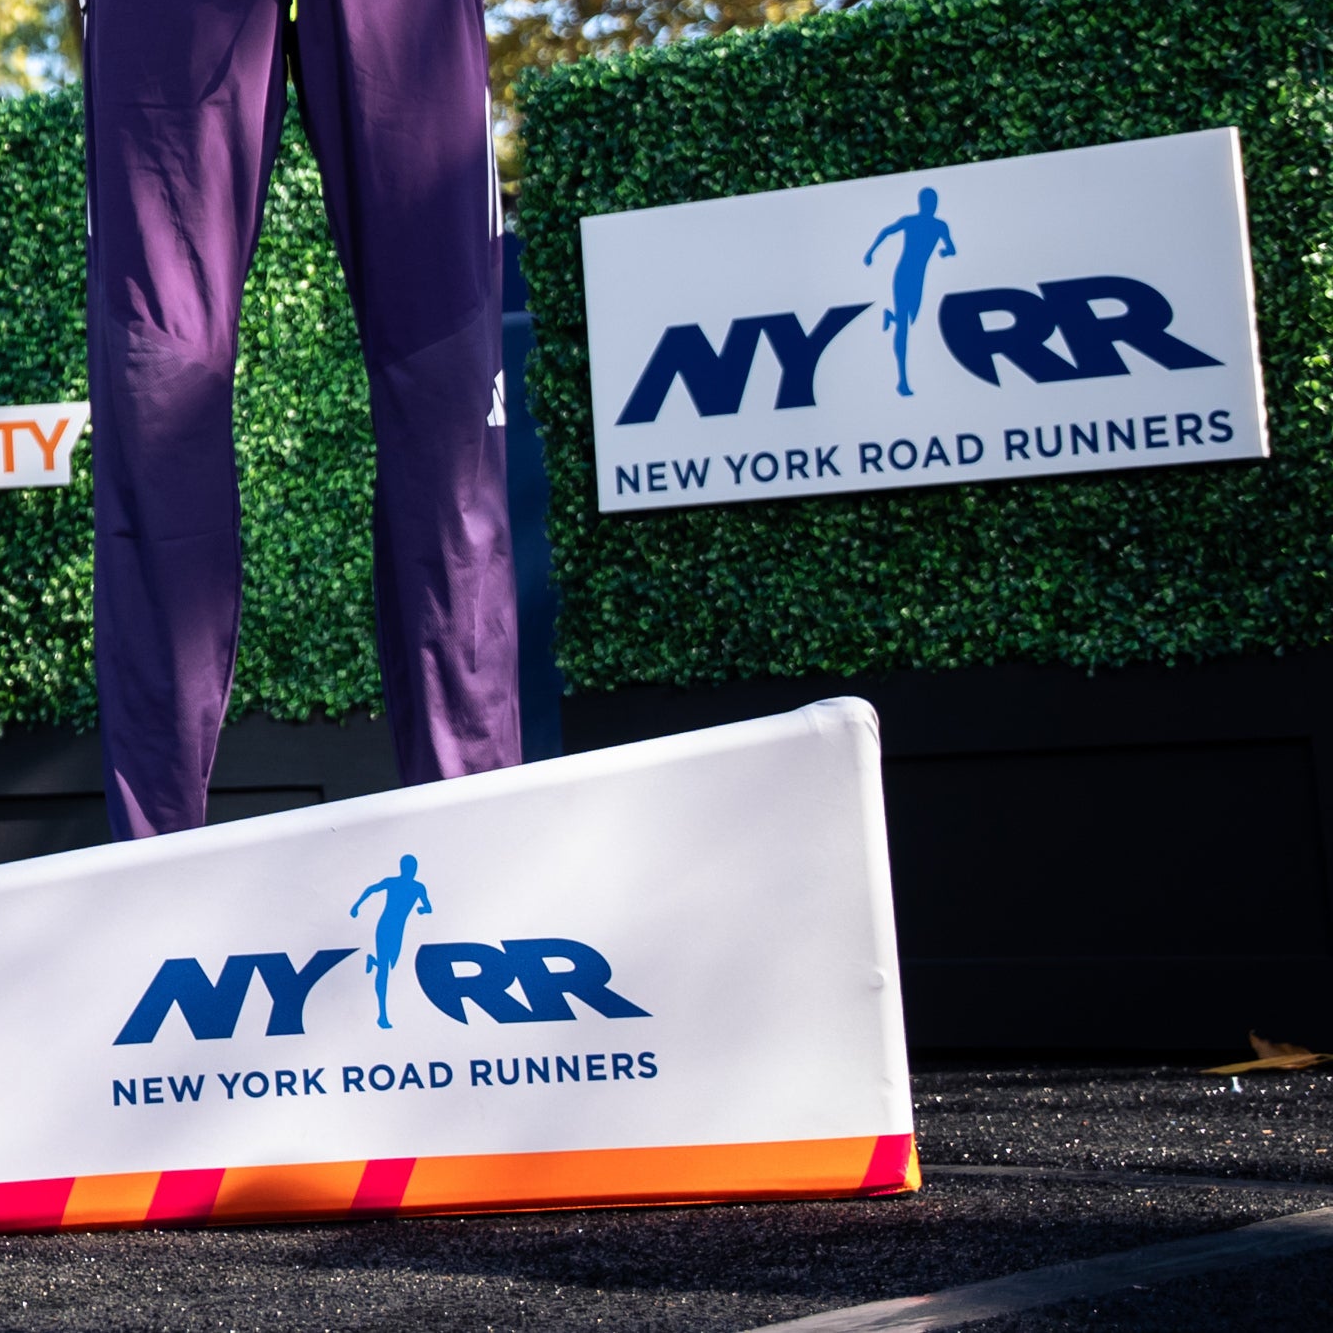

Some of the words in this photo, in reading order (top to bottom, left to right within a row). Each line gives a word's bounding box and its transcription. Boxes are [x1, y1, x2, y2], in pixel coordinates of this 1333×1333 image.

[616, 456, 711, 496] NEW
[723, 444, 841, 485] YORK
[859, 432, 984, 475] ROAD
[1004, 409, 1235, 463] RUNNERS
[112, 1074, 206, 1107] NEW
[217, 1067, 327, 1100] YORK
[342, 1060, 454, 1093] ROAD
[469, 1051, 659, 1087] RUNNERS
